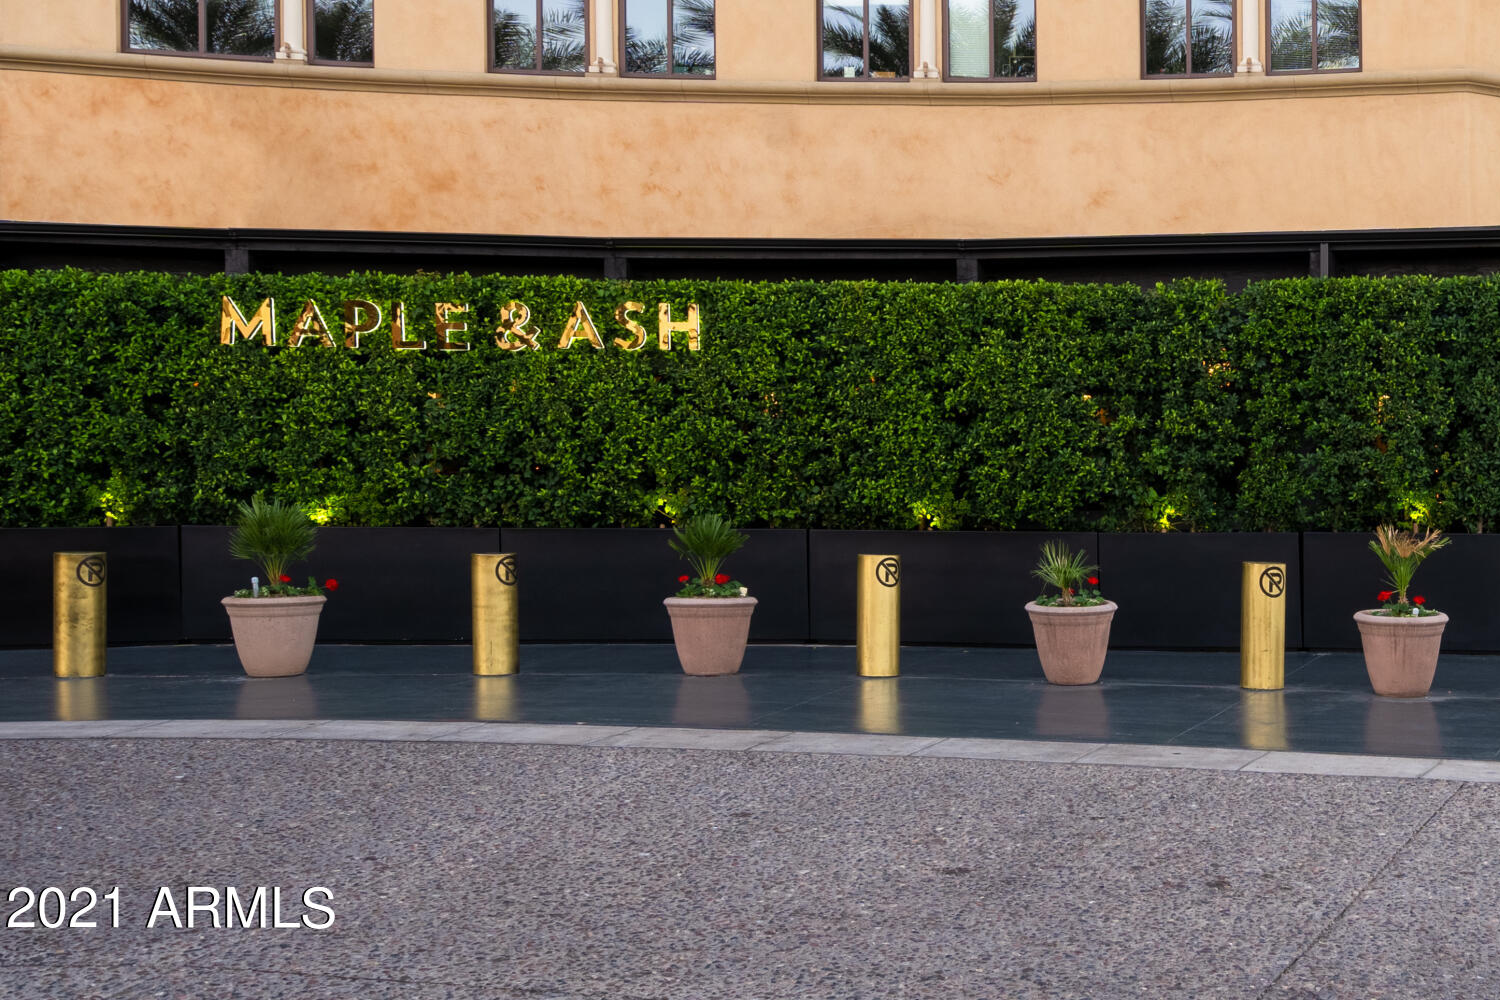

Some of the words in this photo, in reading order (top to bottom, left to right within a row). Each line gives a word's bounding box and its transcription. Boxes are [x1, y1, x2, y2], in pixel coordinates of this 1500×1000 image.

[220, 295, 471, 352] MAPLE
[495, 301, 541, 352] &
[557, 301, 701, 351] ASH
